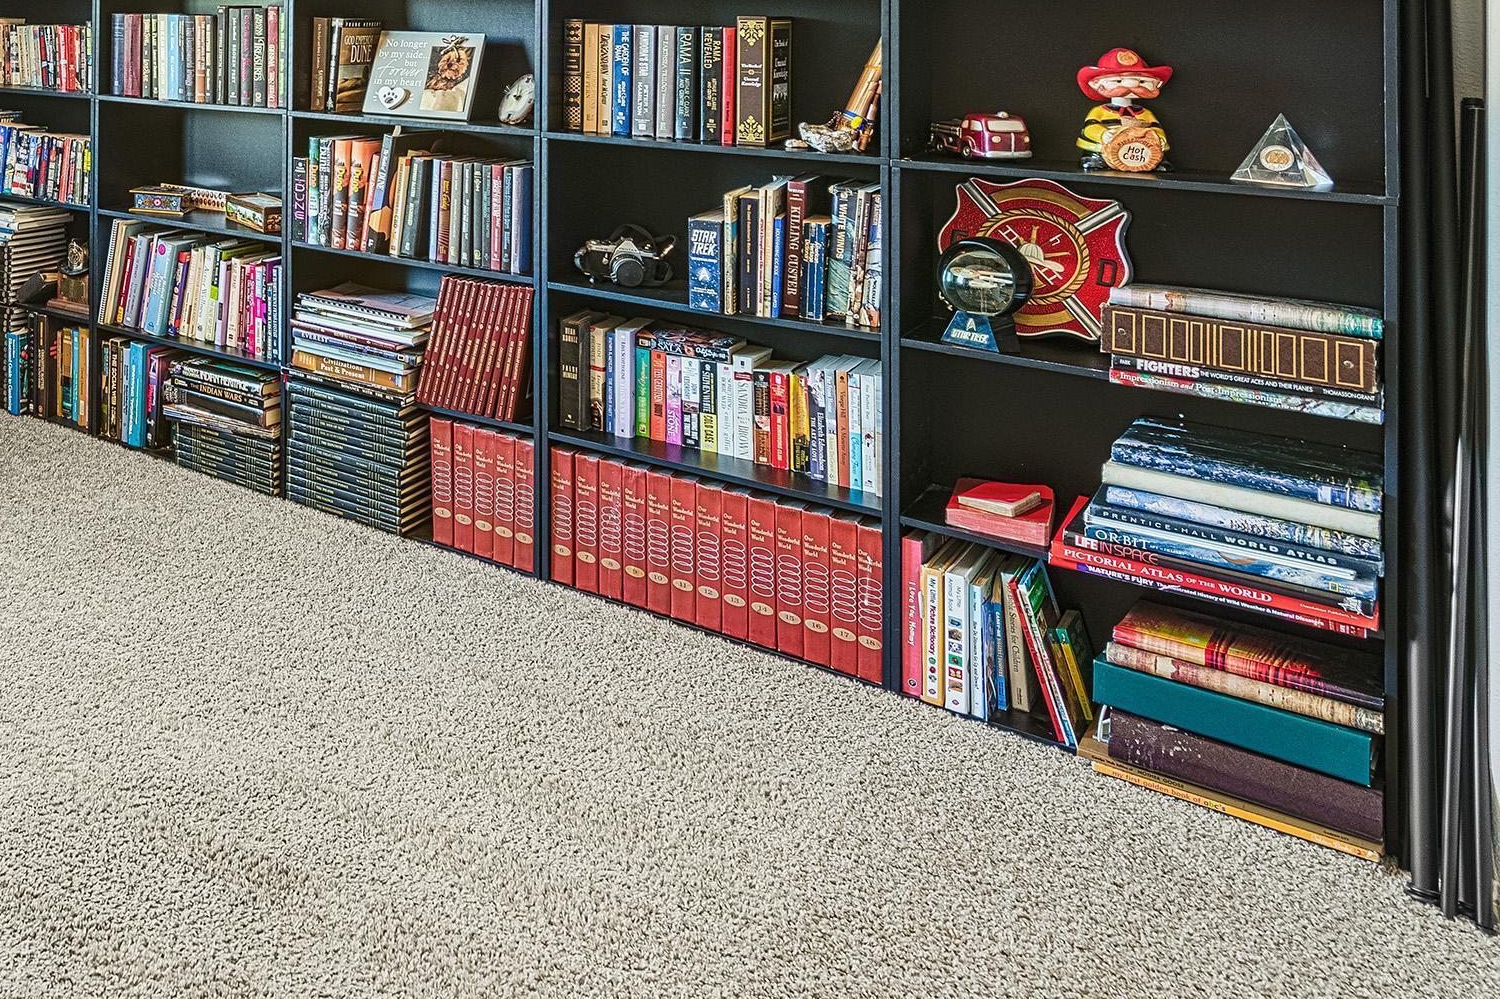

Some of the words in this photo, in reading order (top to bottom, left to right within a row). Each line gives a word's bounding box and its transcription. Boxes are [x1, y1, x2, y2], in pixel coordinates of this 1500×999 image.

[350, 45, 372, 63] DUNE
[386, 38, 399, 48] No
[400, 38, 428, 50] longer
[614, 44, 622, 62] RAMA
[638, 32, 650, 62] PANDORA'S
[680, 33, 692, 64] RAMA
[703, 32, 713, 69] REVEALED
[712, 40, 722, 62] RAMA
[638, 62, 650, 77] STAR
[1122, 152, 1146, 162] Cash
[1127, 146, 1145, 154] Hot
[336, 168, 345, 191] Dune
[353, 168, 362, 192] Dune
[838, 204, 848, 230] WHITE
[788, 206, 802, 250] KILLING
[692, 242, 718, 256] TREK
[835, 230, 846, 260] WINDS
[786, 254, 800, 296] CUSTER
[300, 331, 330, 344] EVEREST
[951, 328, 970, 340] STAR
[970, 331, 989, 345] TREK
[320, 363, 334, 373] Past
[334, 366, 341, 374] &
[341, 367, 365, 379] Present
[323, 356, 364, 372] Civilizations
[1136, 358, 1200, 378] FIGHTERS
[1200, 370, 1210, 378] THE
[1210, 372, 1234, 381] WORLD'S
[1234, 376, 1250, 384] GREAT
[1250, 378, 1264, 386] ACES
[1264, 380, 1278, 388] AND
[1278, 382, 1293, 390] THEIR
[1293, 384, 1314, 393] PLANES
[199, 384, 223, 397] INDIAN
[224, 392, 242, 402] WARS
[738, 382, 749, 414] SANDRA
[668, 410, 676, 436] STONE
[703, 415, 714, 430] COLD
[704, 429, 714, 443] CASE
[738, 424, 750, 457] BROWN
[851, 436, 859, 459] Changing
[578, 482, 596, 492] Wonderful
[648, 500, 668, 510] Wonderful
[804, 541, 828, 553] Wonderful
[1075, 535, 1099, 550] LIFE
[1099, 541, 1112, 555] IN
[1113, 544, 1159, 565] SPACE
[1095, 529, 1151, 550] ORBIT
[804, 548, 818, 558] World
[654, 574, 664, 582] 10
[928, 578, 936, 588] My
[1063, 549, 1136, 572] PICTORIAL
[1140, 568, 1184, 582] ATLAS
[1198, 580, 1215, 589] THE
[1218, 584, 1273, 602] WORLD
[1087, 564, 1131, 581] NATURE'S
[1131, 576, 1154, 587] FURY
[1197, 591, 1219, 602] History
[1218, 596, 1226, 604] of
[1226, 598, 1241, 608] Wild
[1241, 601, 1266, 612] Weather
[1266, 606, 1272, 614] &
[1272, 608, 1295, 620] Natural
[1295, 612, 1325, 627] Disasters
[929, 604, 937, 625] Picture
[928, 626, 937, 655] Dictionary
[1137, 770, 1160, 781] MOTHER
[1162, 778, 1185, 789] GOOSE
[1112, 770, 1124, 779] my
[1126, 774, 1141, 783] first
[1142, 780, 1169, 793] golden
[1171, 788, 1190, 801] book
[1192, 796, 1201, 804] of
[1203, 800, 1226, 812] abc's
